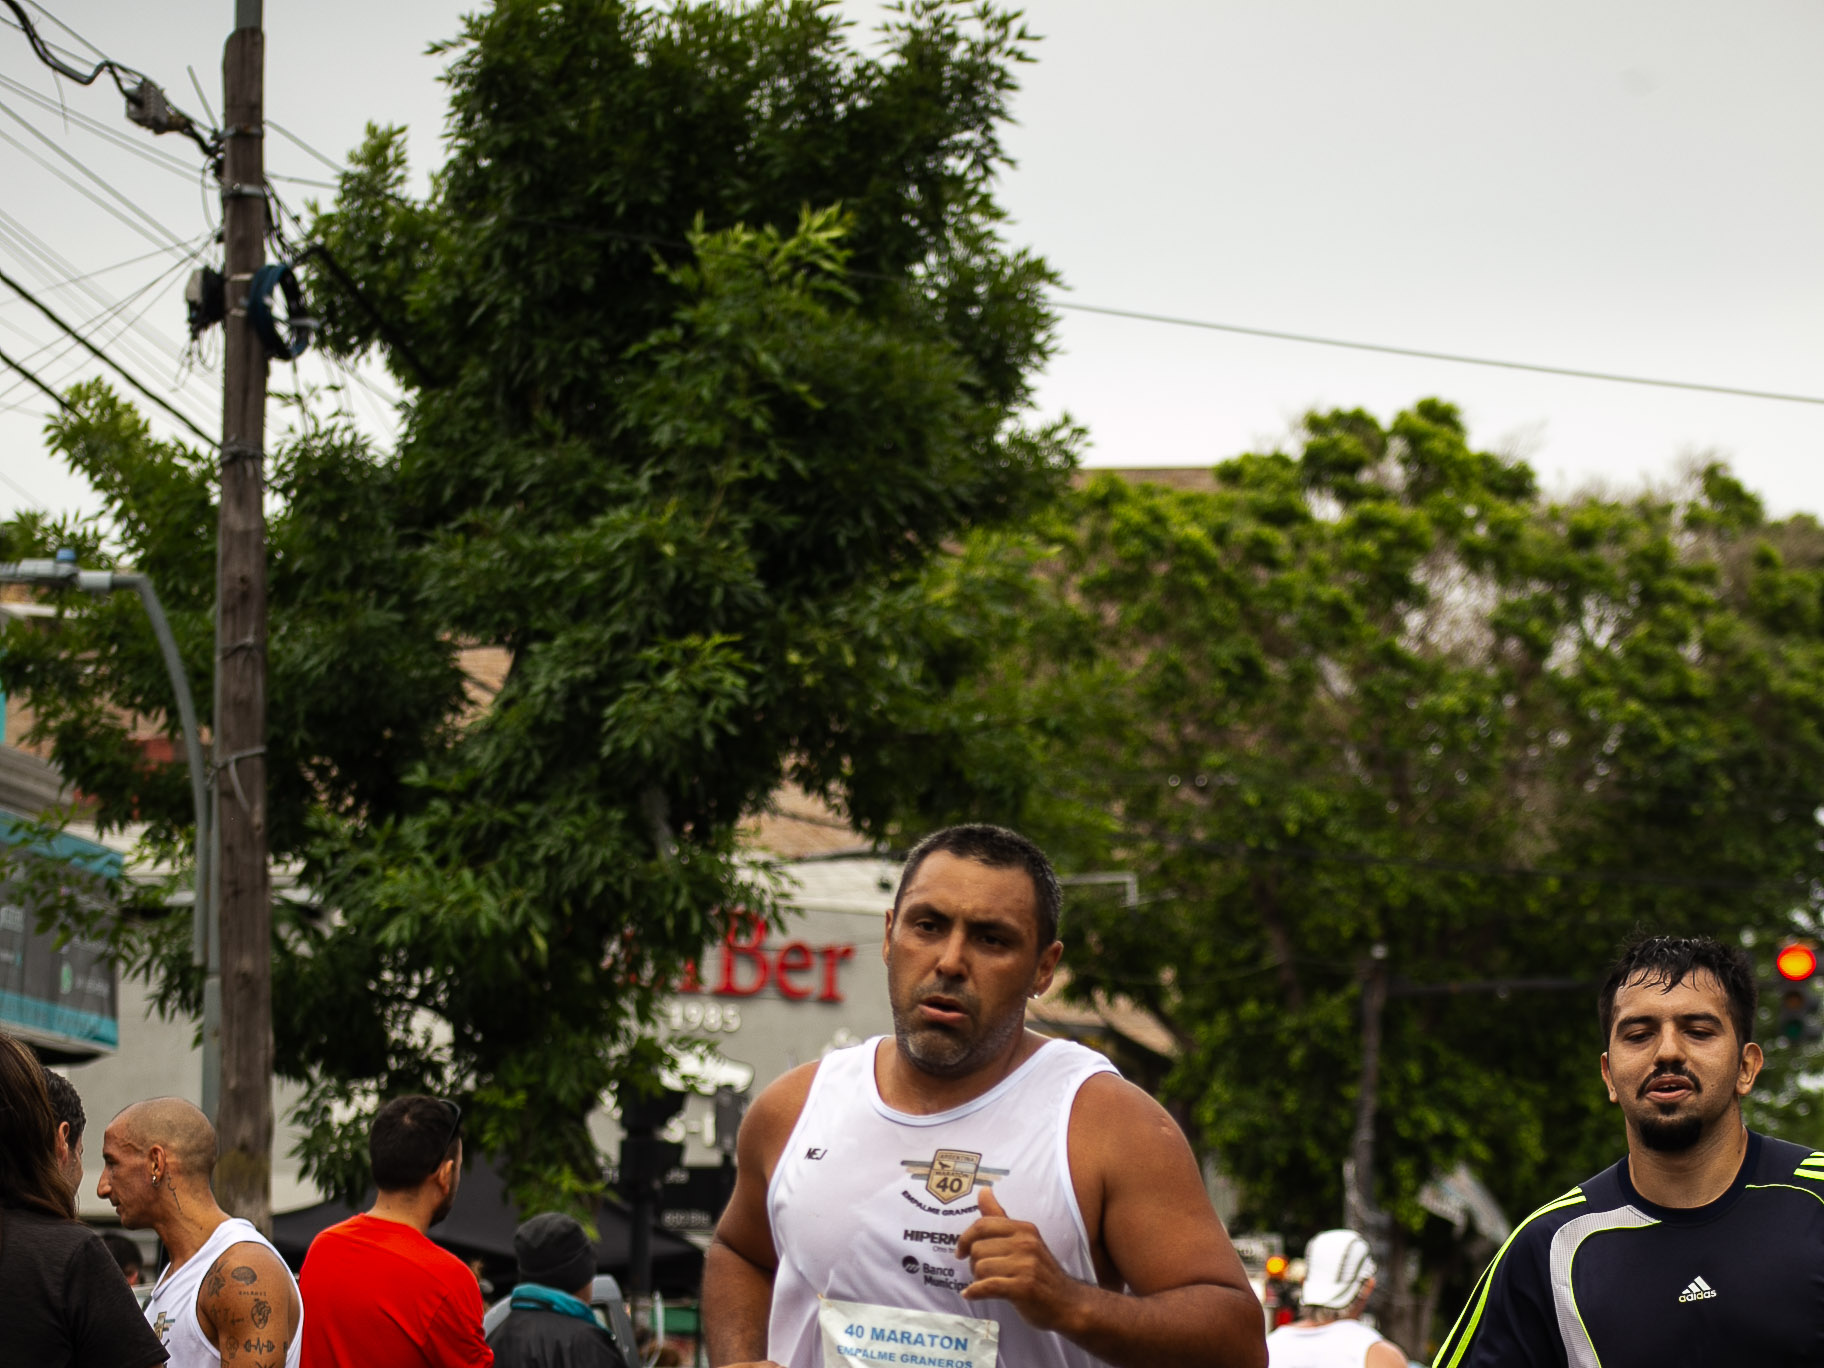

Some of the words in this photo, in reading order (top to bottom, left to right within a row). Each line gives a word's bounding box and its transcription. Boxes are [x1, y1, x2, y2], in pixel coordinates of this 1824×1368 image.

[936, 1177, 963, 1193] 40
[901, 1190, 941, 1215] EMPALME
[923, 1262, 955, 1278] Banco
[924, 1275, 974, 1294] Municip
[1678, 1289, 1717, 1303] adidas
[844, 1323, 865, 1339] 40
[870, 1326, 969, 1352] MARATON
[836, 1344, 897, 1362] EMPALME
